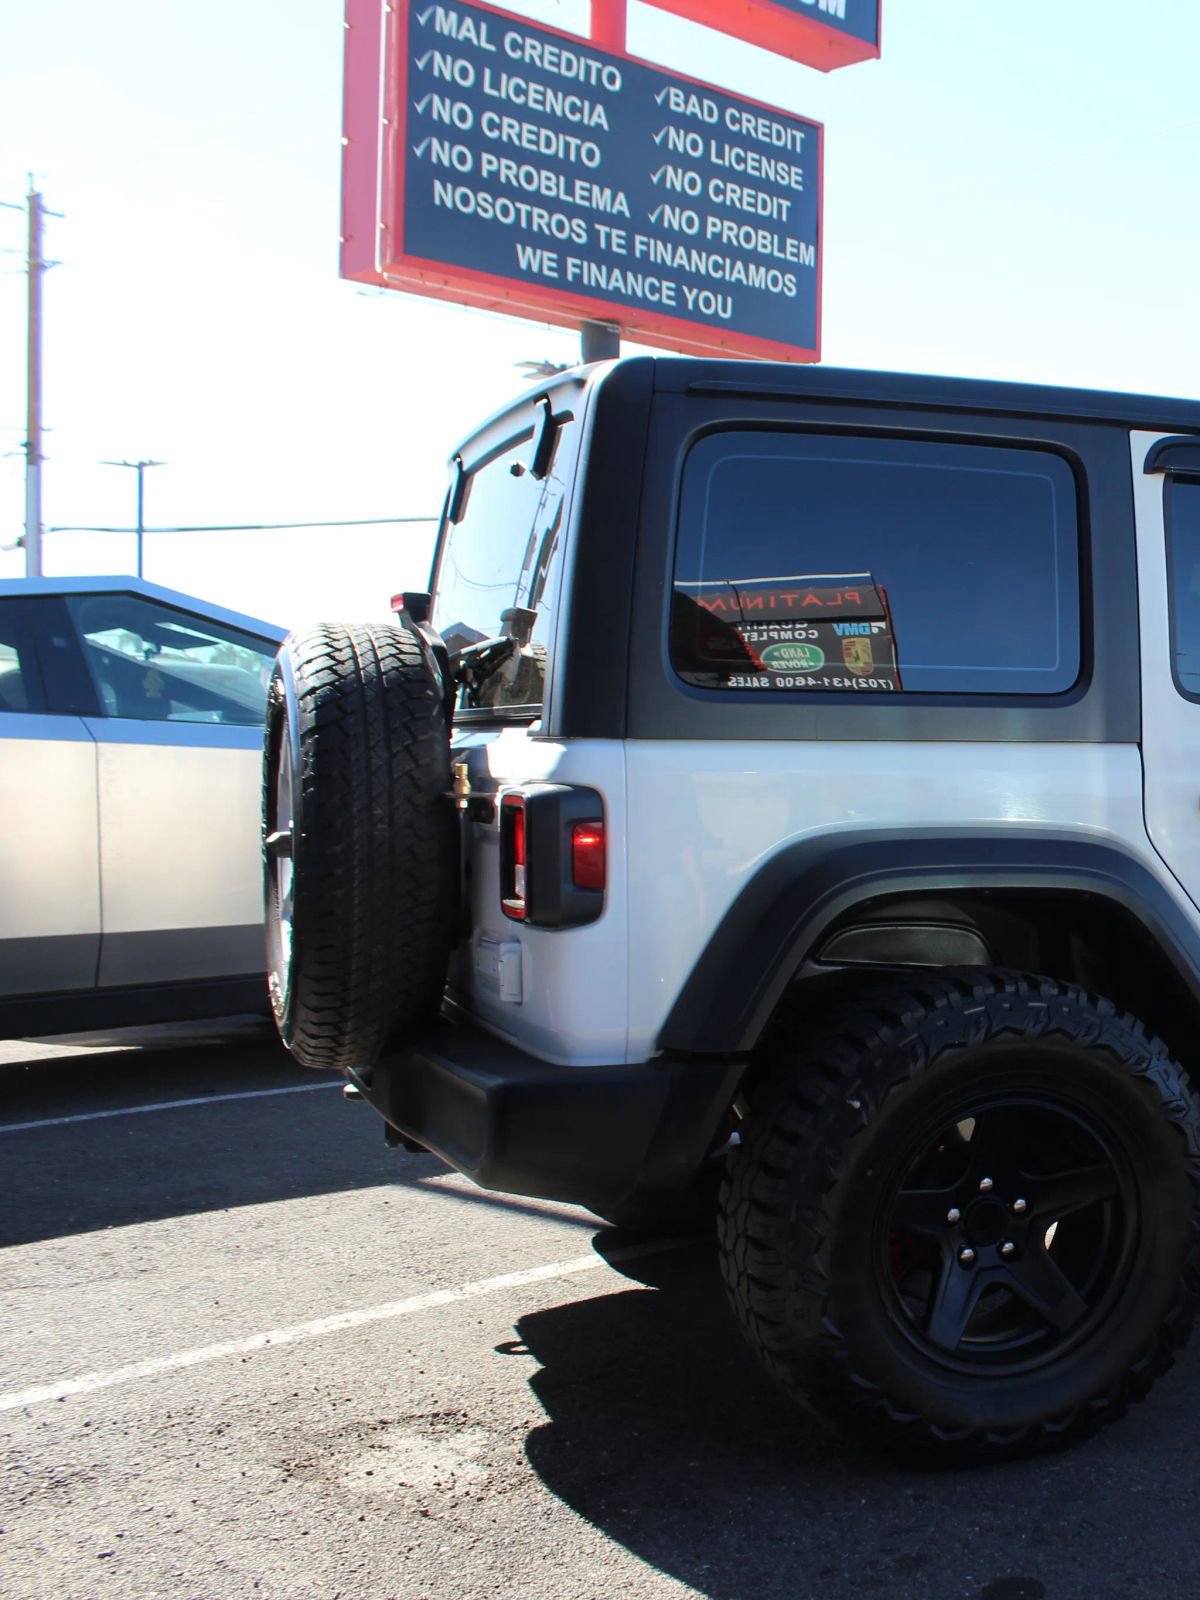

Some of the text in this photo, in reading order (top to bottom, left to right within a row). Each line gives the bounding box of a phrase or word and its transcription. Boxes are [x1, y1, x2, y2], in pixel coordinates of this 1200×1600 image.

[434, 5, 622, 92] MAL CREDITO
[432, 50, 609, 131] NO LICENCIA
[669, 86, 805, 153] BAD CREDIT
[431, 93, 601, 168] NO CREDITO
[668, 125, 803, 190] NO LICENSE
[430, 137, 630, 218] NO PROBLEMA
[665, 165, 791, 222] NO CREDIT
[433, 179, 797, 297] NOSOTROS TE FINANCIAMOS
[663, 204, 815, 268] NO PROBLEM
[516, 243, 732, 318] WE FINANCE YOU
